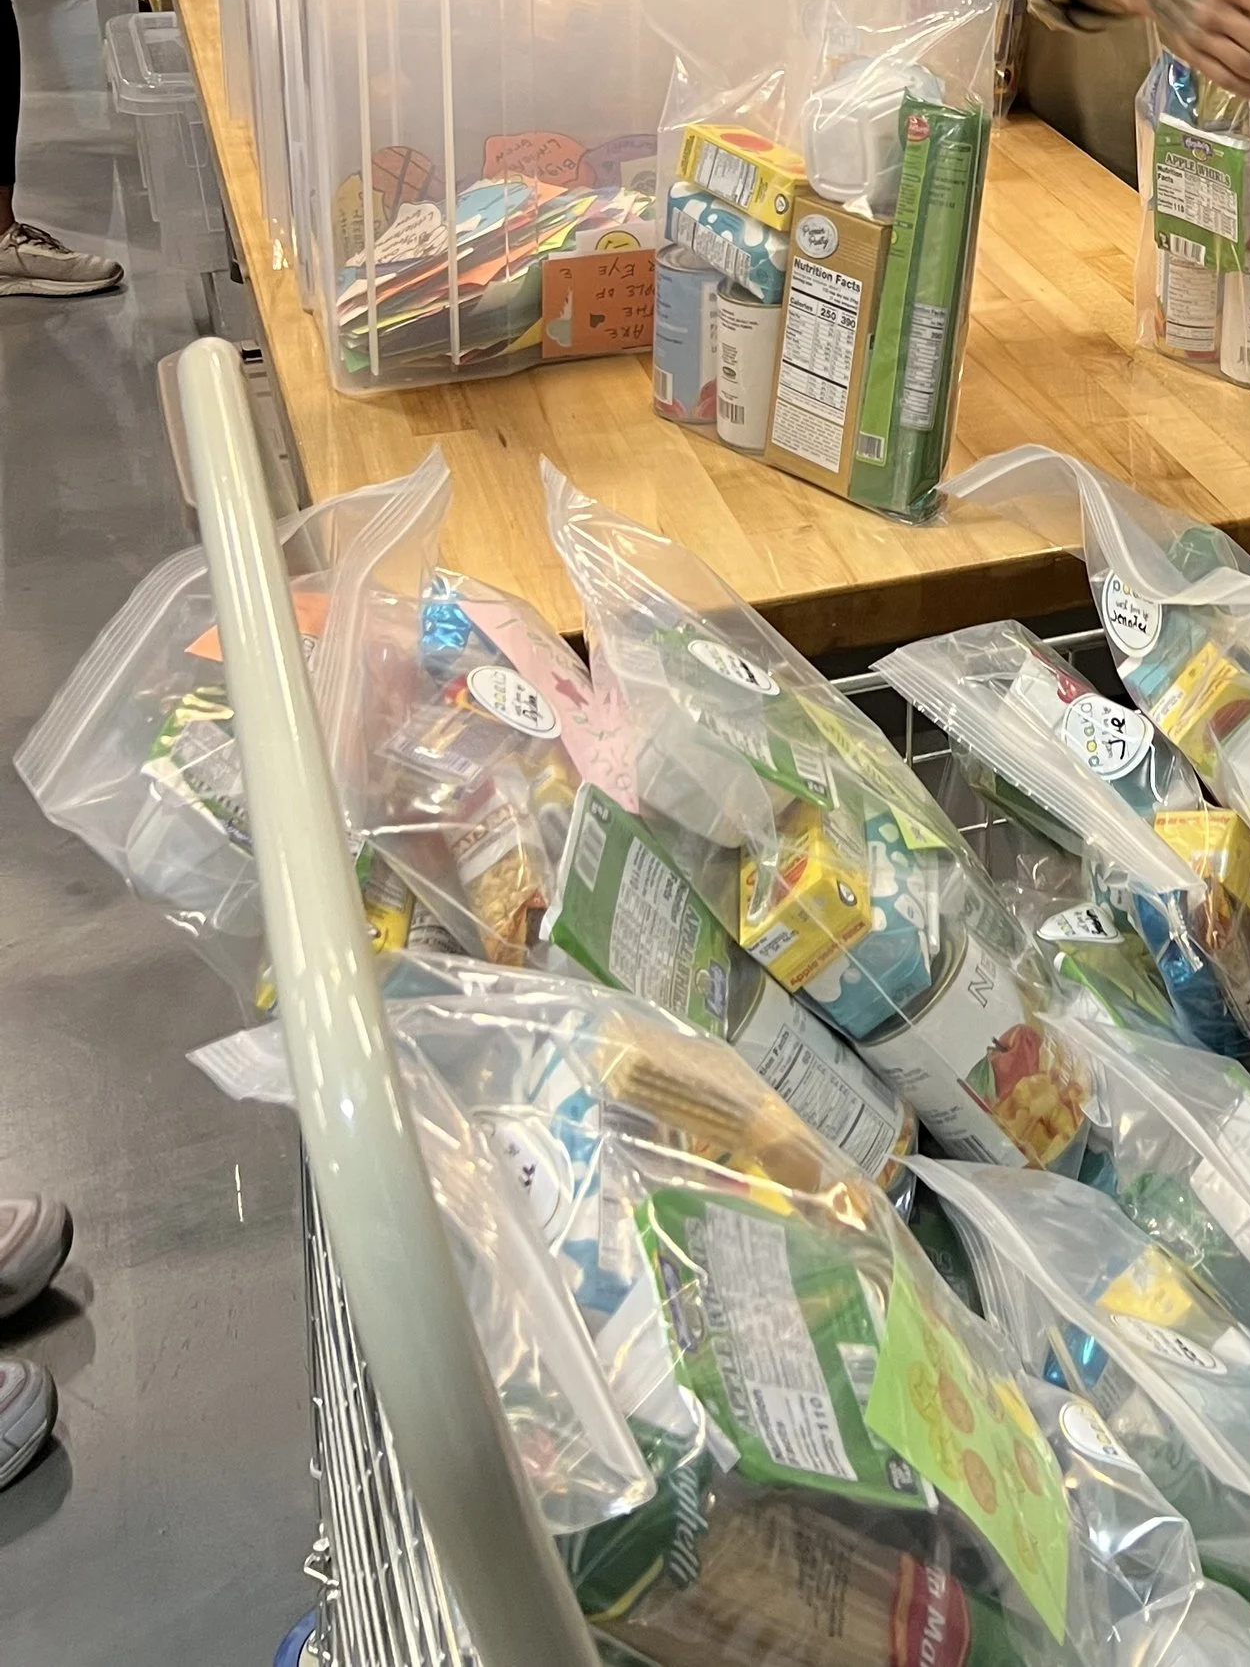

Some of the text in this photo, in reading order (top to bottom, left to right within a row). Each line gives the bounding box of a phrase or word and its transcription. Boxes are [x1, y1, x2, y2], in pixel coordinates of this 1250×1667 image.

[1165, 152, 1231, 189] APPLE WHIRLS
[794, 258, 861, 293] Nutrition Facts
[790, 297, 856, 329] Calories 250 390
[712, 1337, 756, 1433] APPLE
